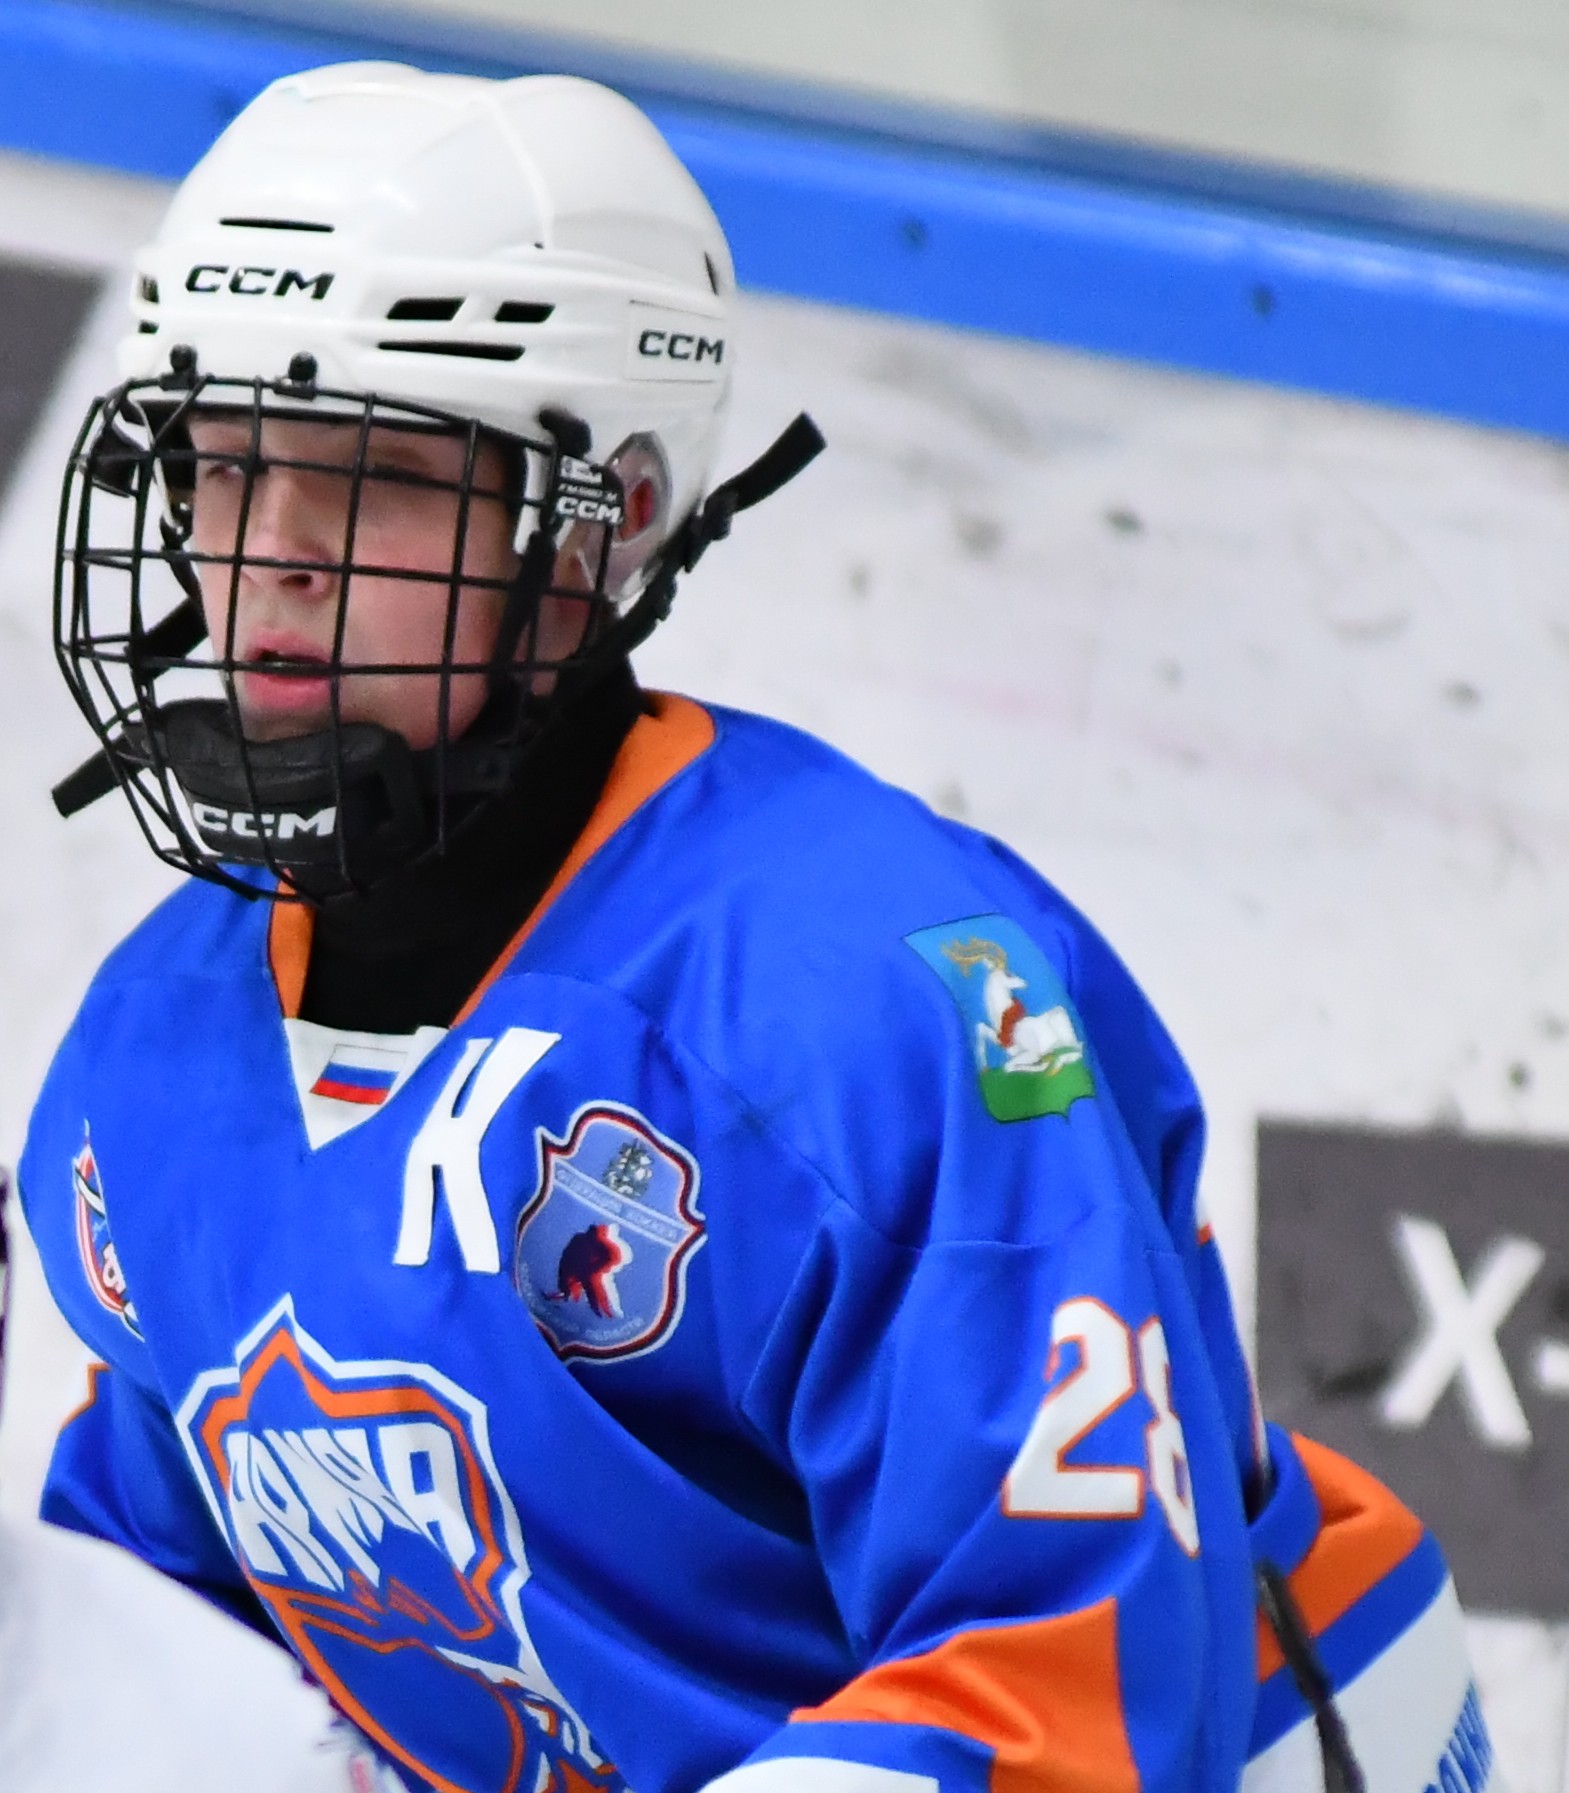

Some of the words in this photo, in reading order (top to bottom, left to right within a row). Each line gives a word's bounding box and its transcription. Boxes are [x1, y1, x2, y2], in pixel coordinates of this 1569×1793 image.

[184, 264, 335, 301] CCM
[638, 330, 725, 365] CCM
[556, 496, 621, 523] CCM
[192, 802, 337, 839] CCM
[1000, 1295, 1201, 1560] 28
